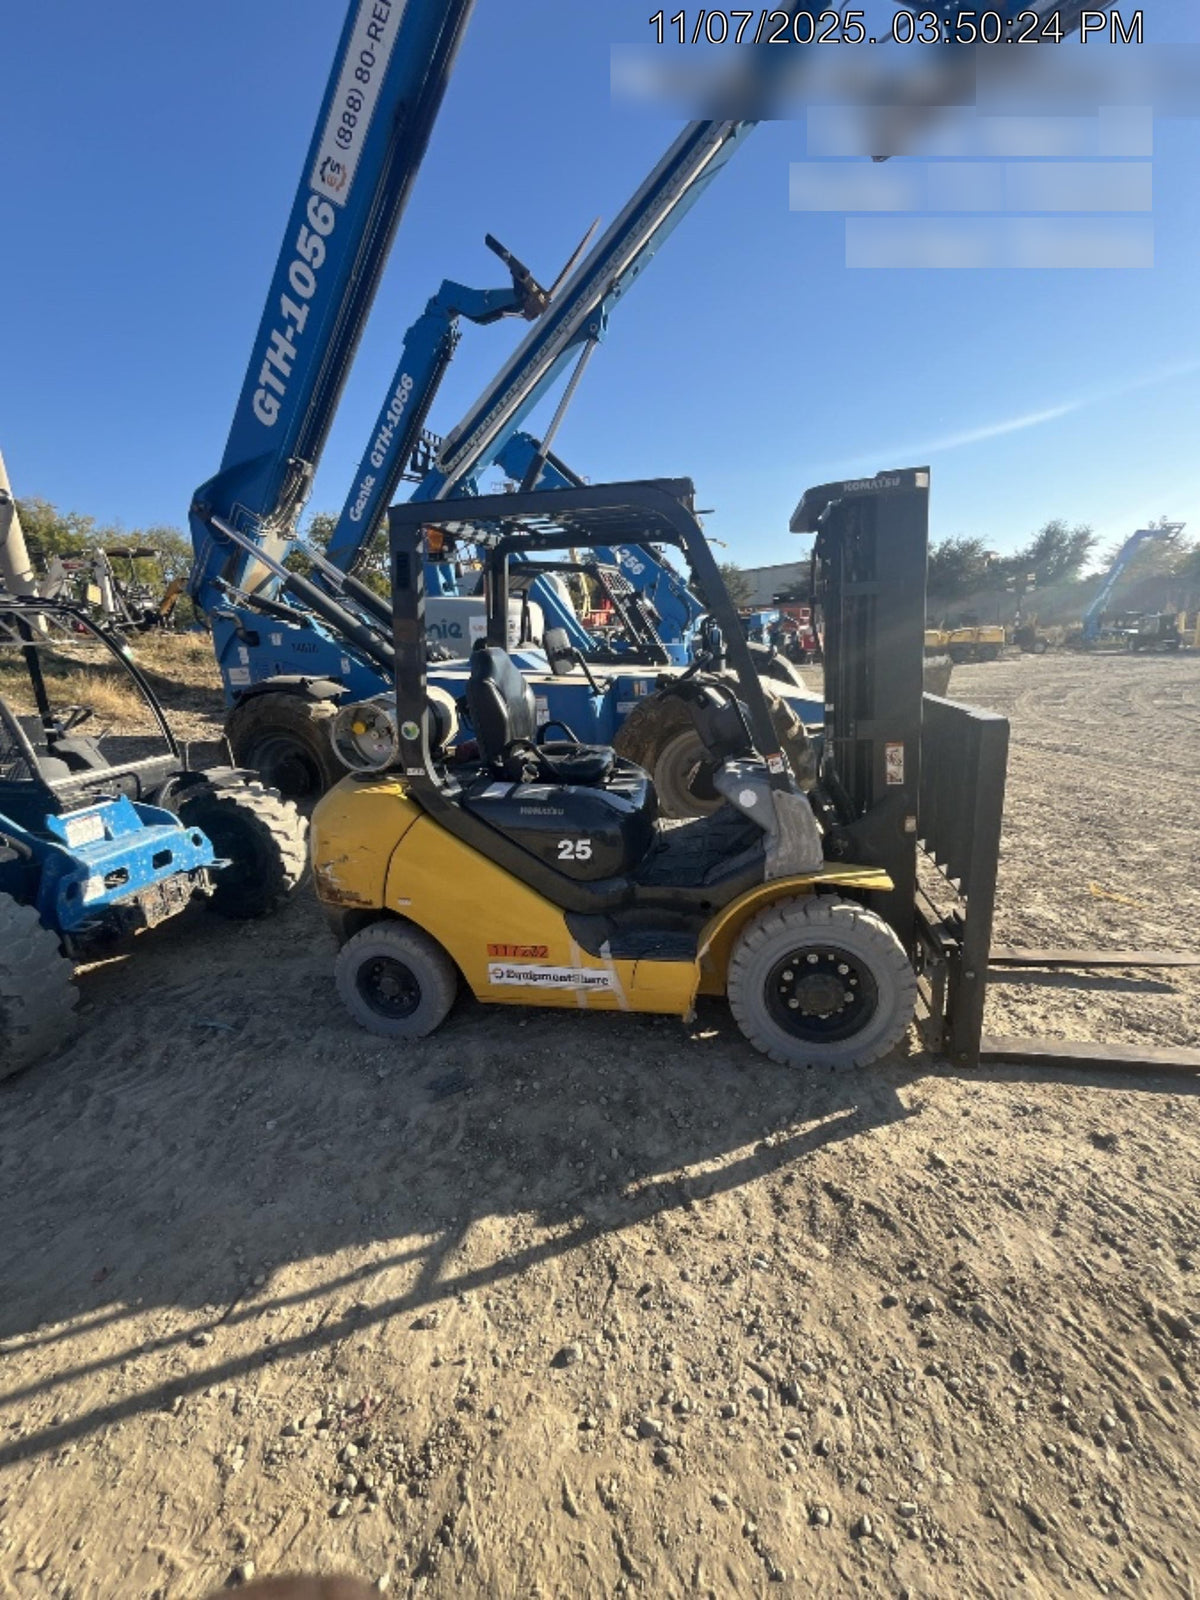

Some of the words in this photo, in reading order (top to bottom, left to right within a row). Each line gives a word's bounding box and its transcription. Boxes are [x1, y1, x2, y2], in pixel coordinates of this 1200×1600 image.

[336, 88, 364, 150] (888)
[253, 195, 335, 427] GTH-1056
[350, 474, 376, 522] Genie
[370, 373, 413, 468] GTH-1056
[843, 476, 900, 492] KOMATSU
[557, 839, 592, 860] 25
